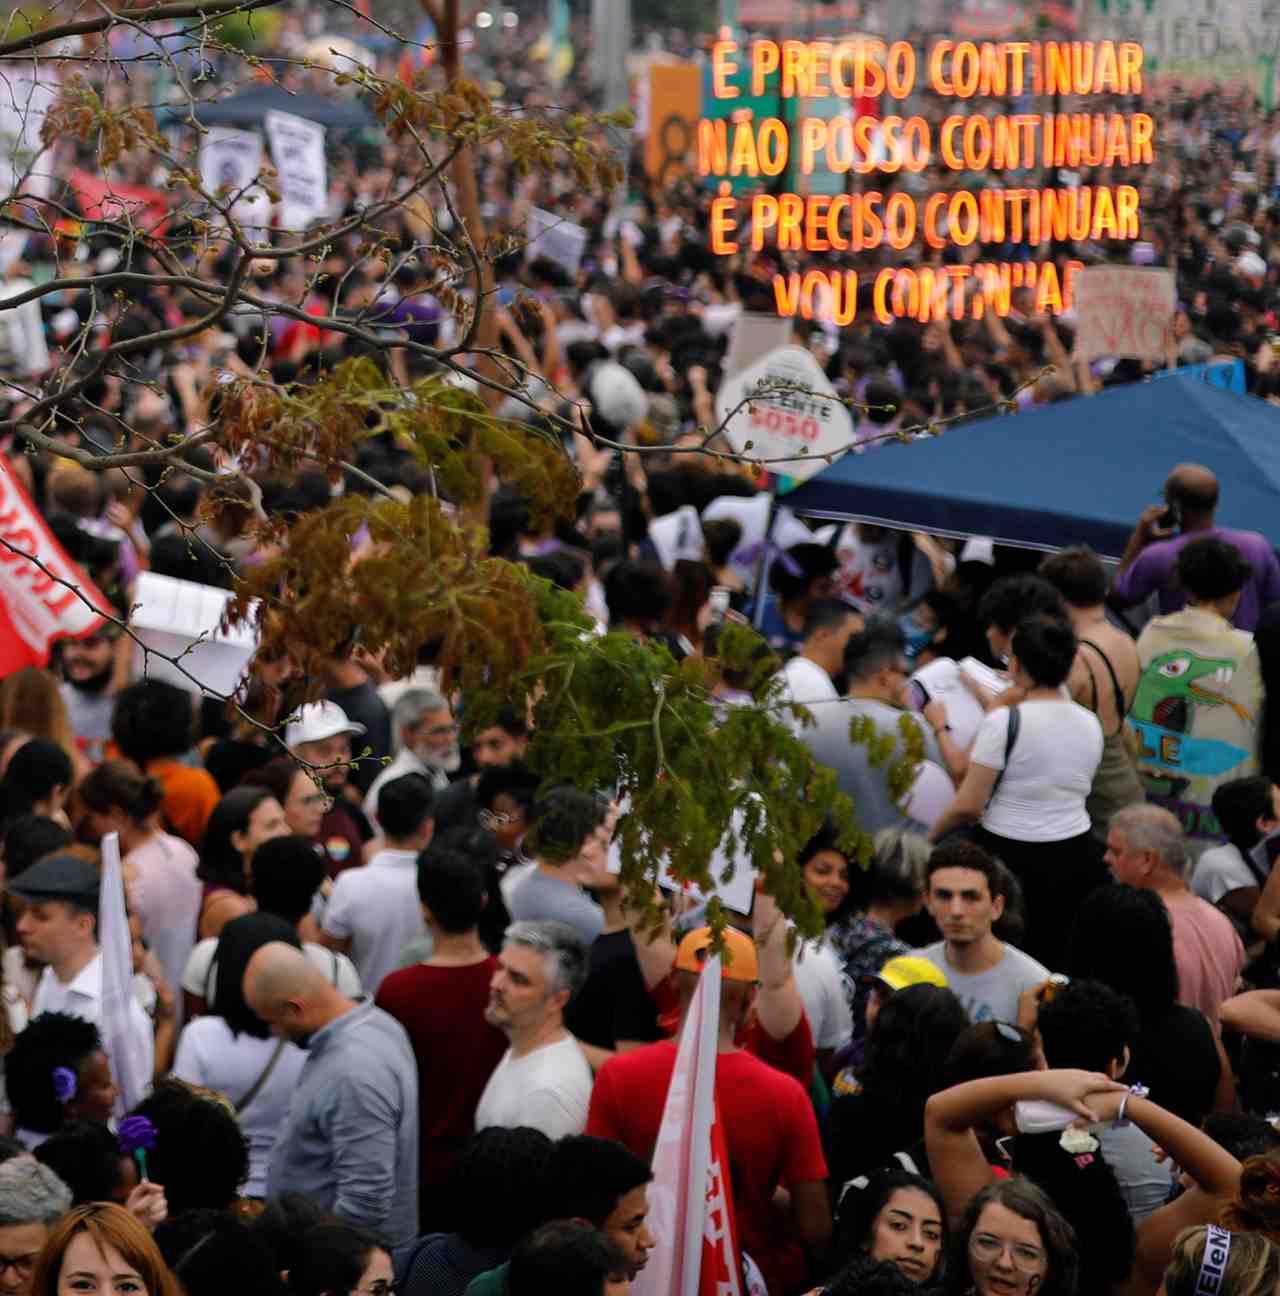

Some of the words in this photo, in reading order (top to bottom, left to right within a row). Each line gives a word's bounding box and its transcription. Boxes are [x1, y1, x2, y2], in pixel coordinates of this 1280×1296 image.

[712, 26, 740, 98] É
[752, 39, 916, 99] PRECISO
[931, 39, 1143, 97] CONTINUAR
[698, 108, 789, 176] NÃO
[801, 115, 930, 175] POSSO
[941, 112, 1153, 171] CONTINUAR
[711, 180, 738, 254] É
[751, 191, 916, 252] PRECISO
[925, 185, 1139, 249] CONTINUAR
[773, 268, 857, 326] VOU
